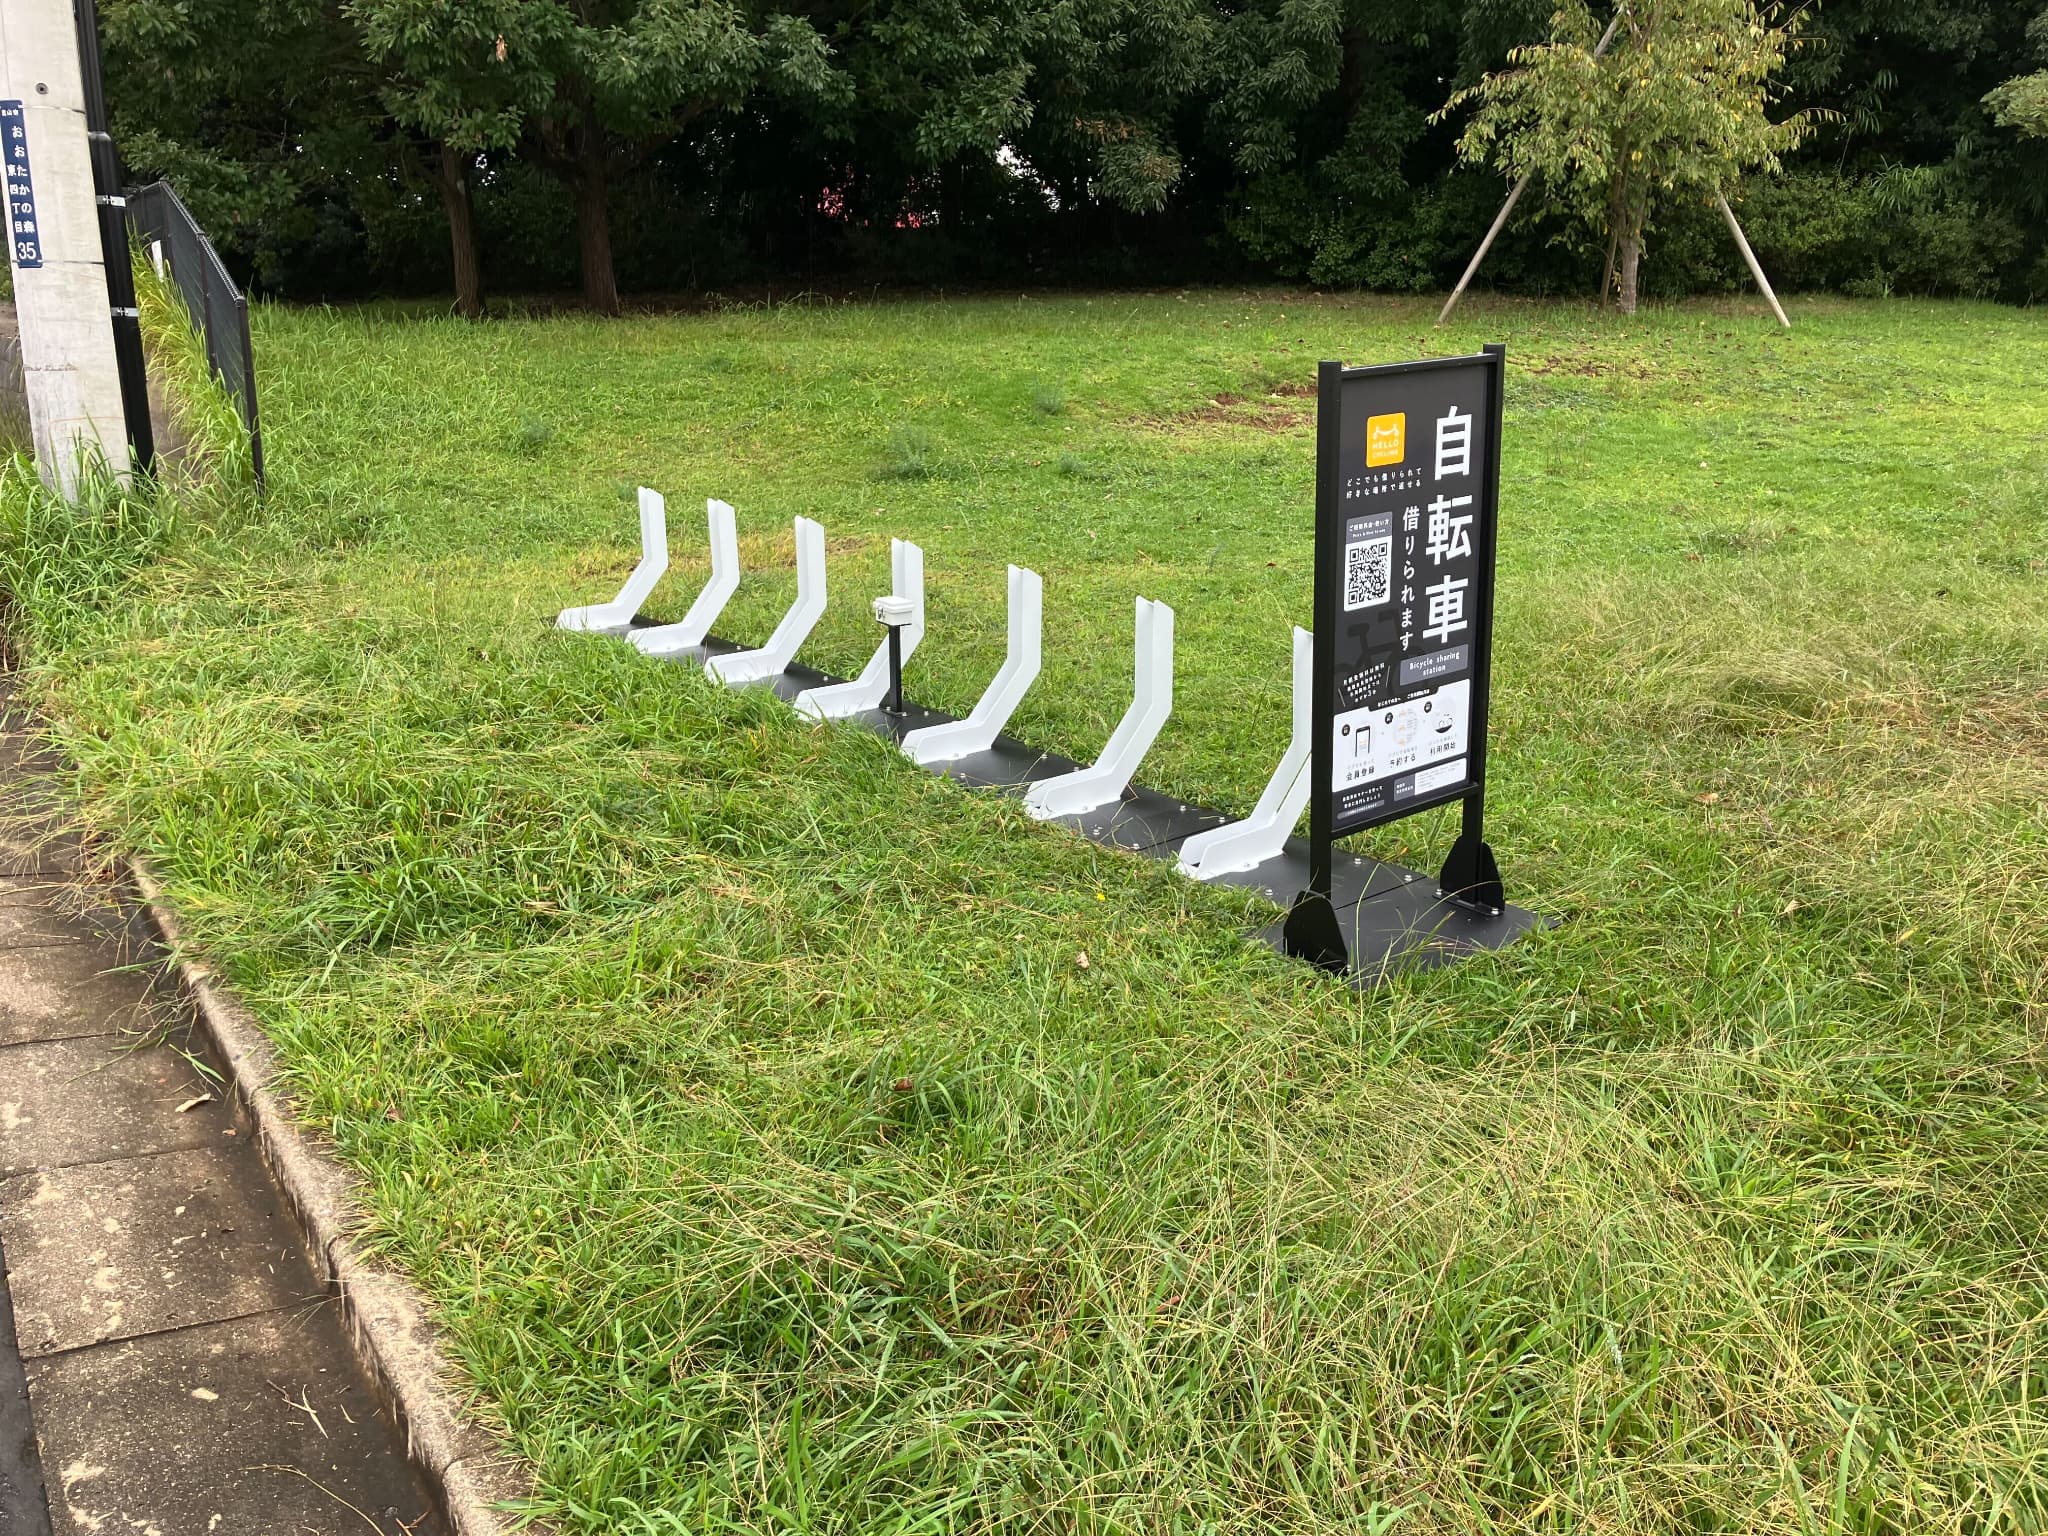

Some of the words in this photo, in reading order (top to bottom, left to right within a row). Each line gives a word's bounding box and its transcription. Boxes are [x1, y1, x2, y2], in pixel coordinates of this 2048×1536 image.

[12, 125, 35, 233] おおたかの森
[17, 241, 37, 260] 35
[1372, 439, 1399, 450] HELLO
[1422, 405, 1473, 644] 自転車
[1399, 505, 1421, 652] 借りられます
[1409, 657, 1434, 671] Bicycle
[1436, 651, 1461, 664] sharing
[1422, 664, 1446, 676] station
